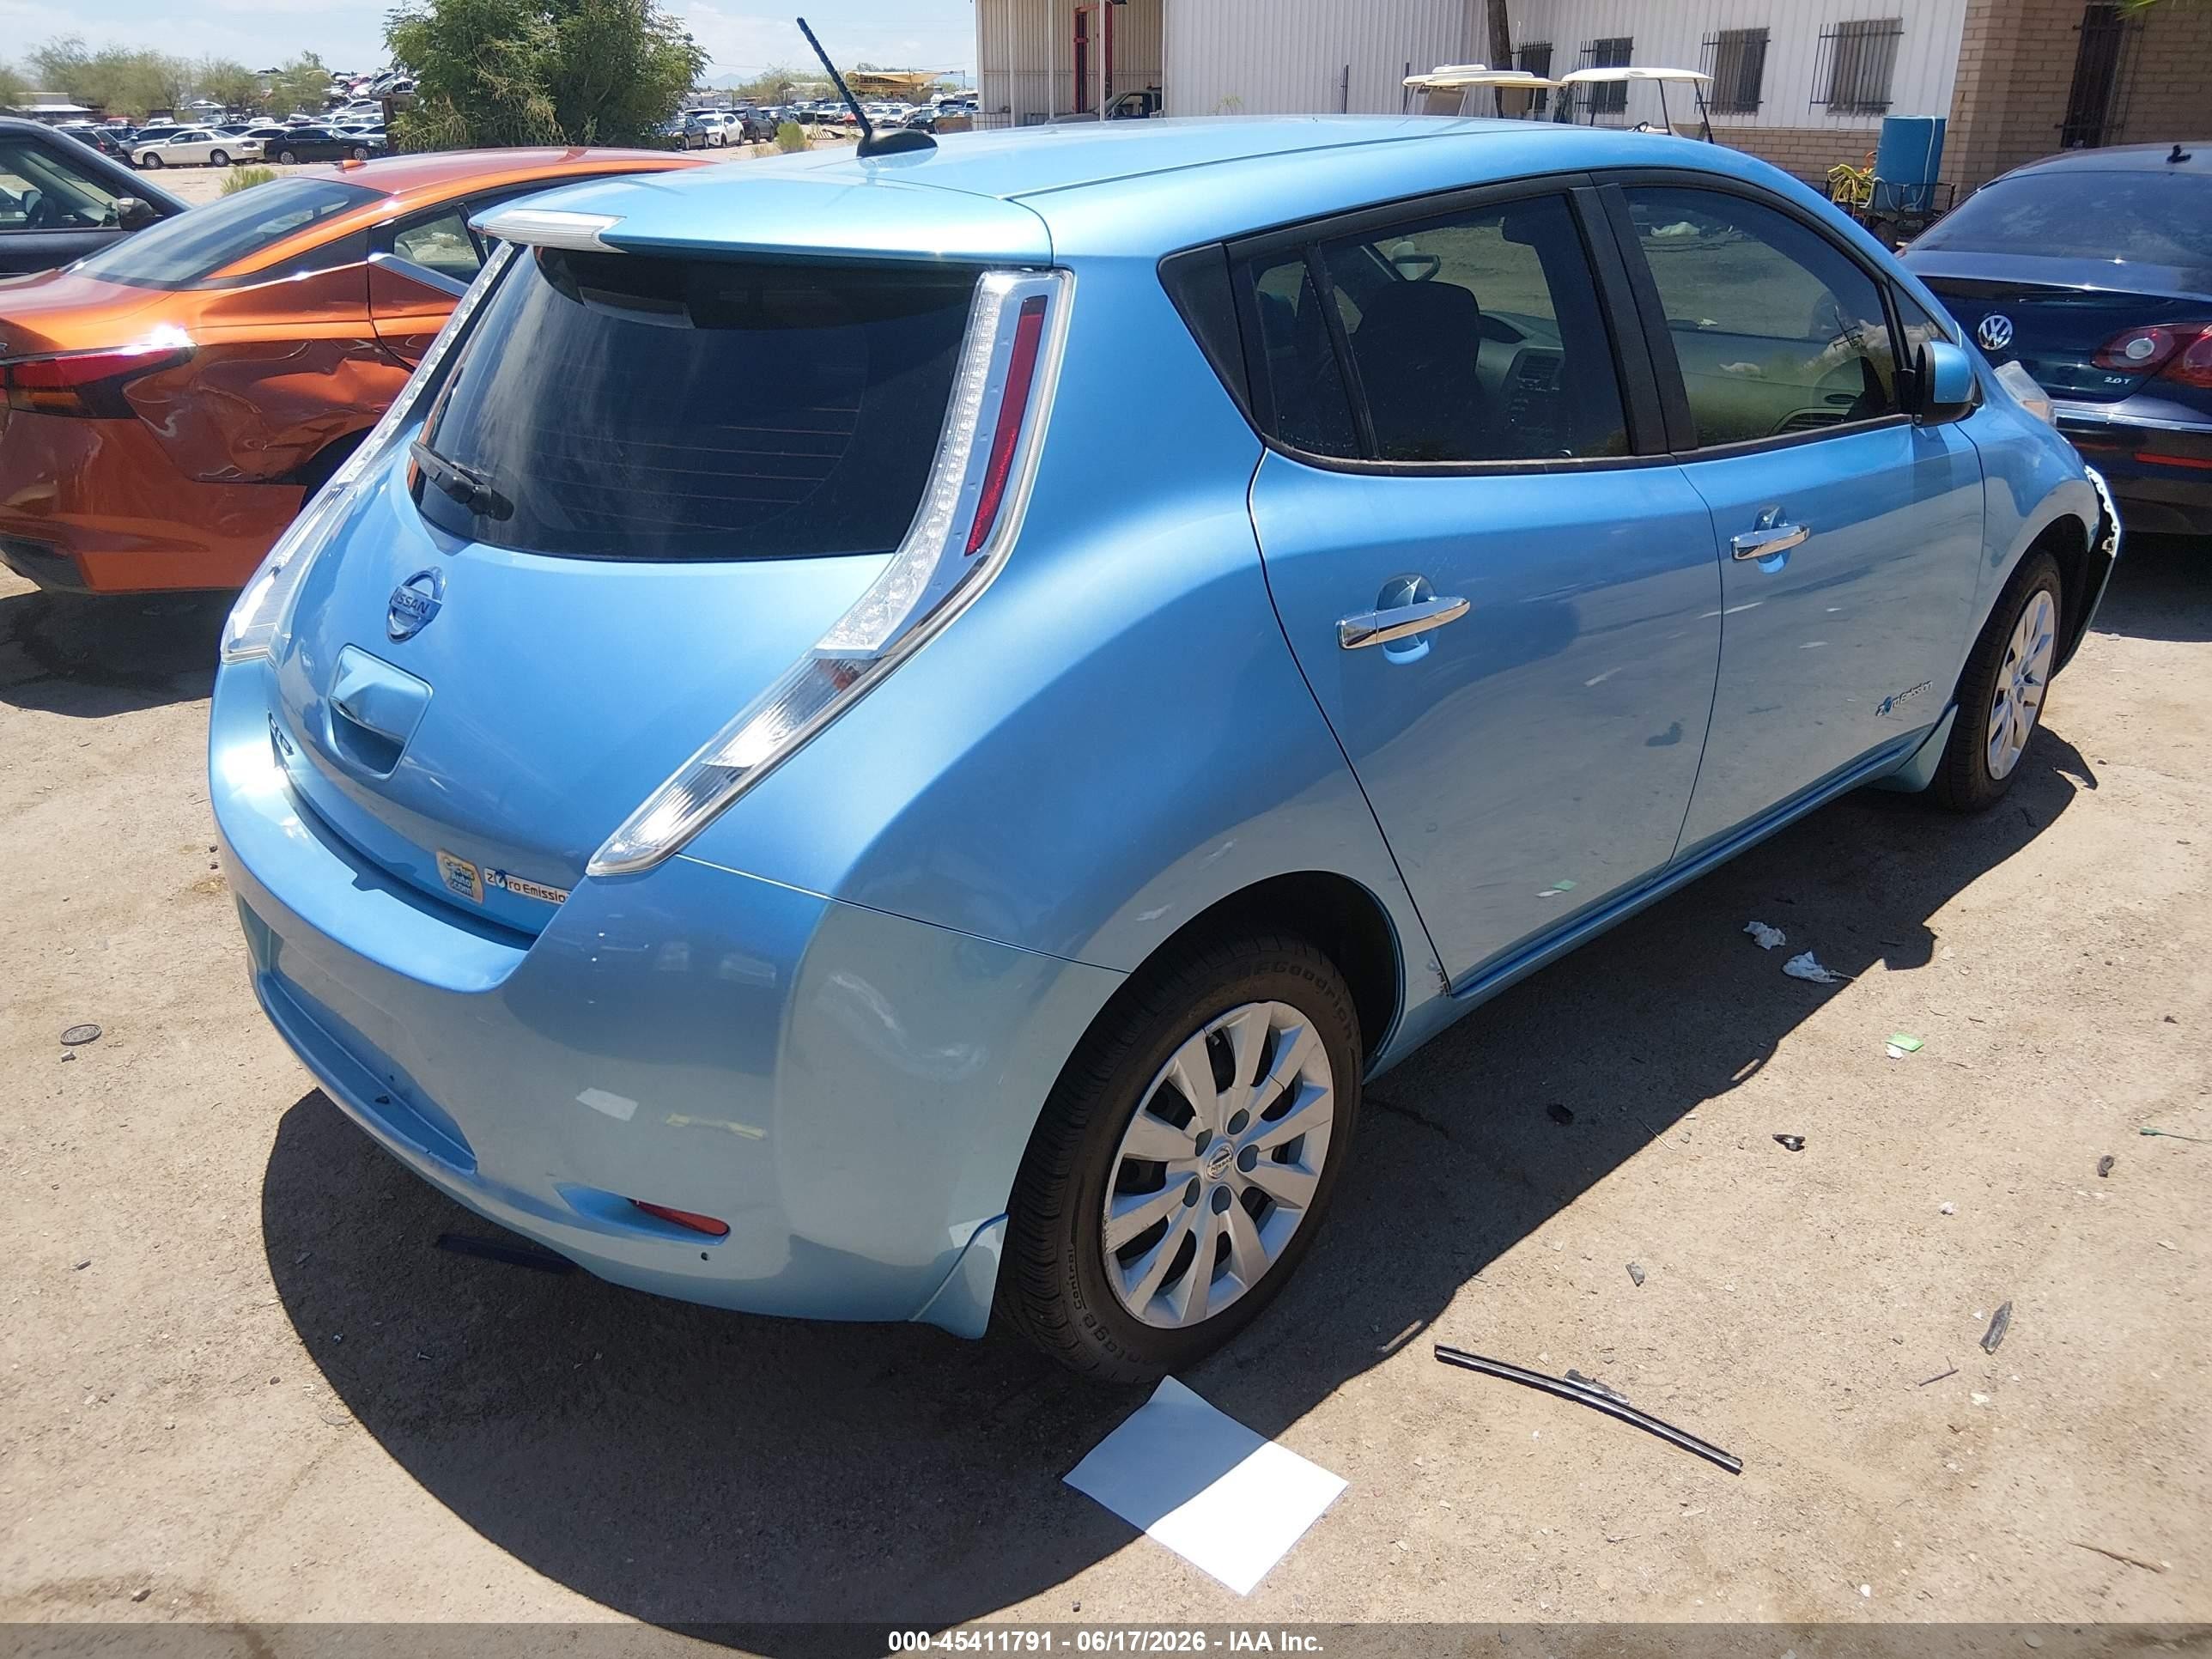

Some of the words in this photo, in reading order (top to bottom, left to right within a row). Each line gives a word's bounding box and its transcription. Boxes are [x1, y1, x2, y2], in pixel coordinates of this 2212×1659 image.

[393, 591, 431, 615] ISSAN
[523, 884, 570, 903] Emissio
[1238, 961, 1353, 1042] FGoodrich
